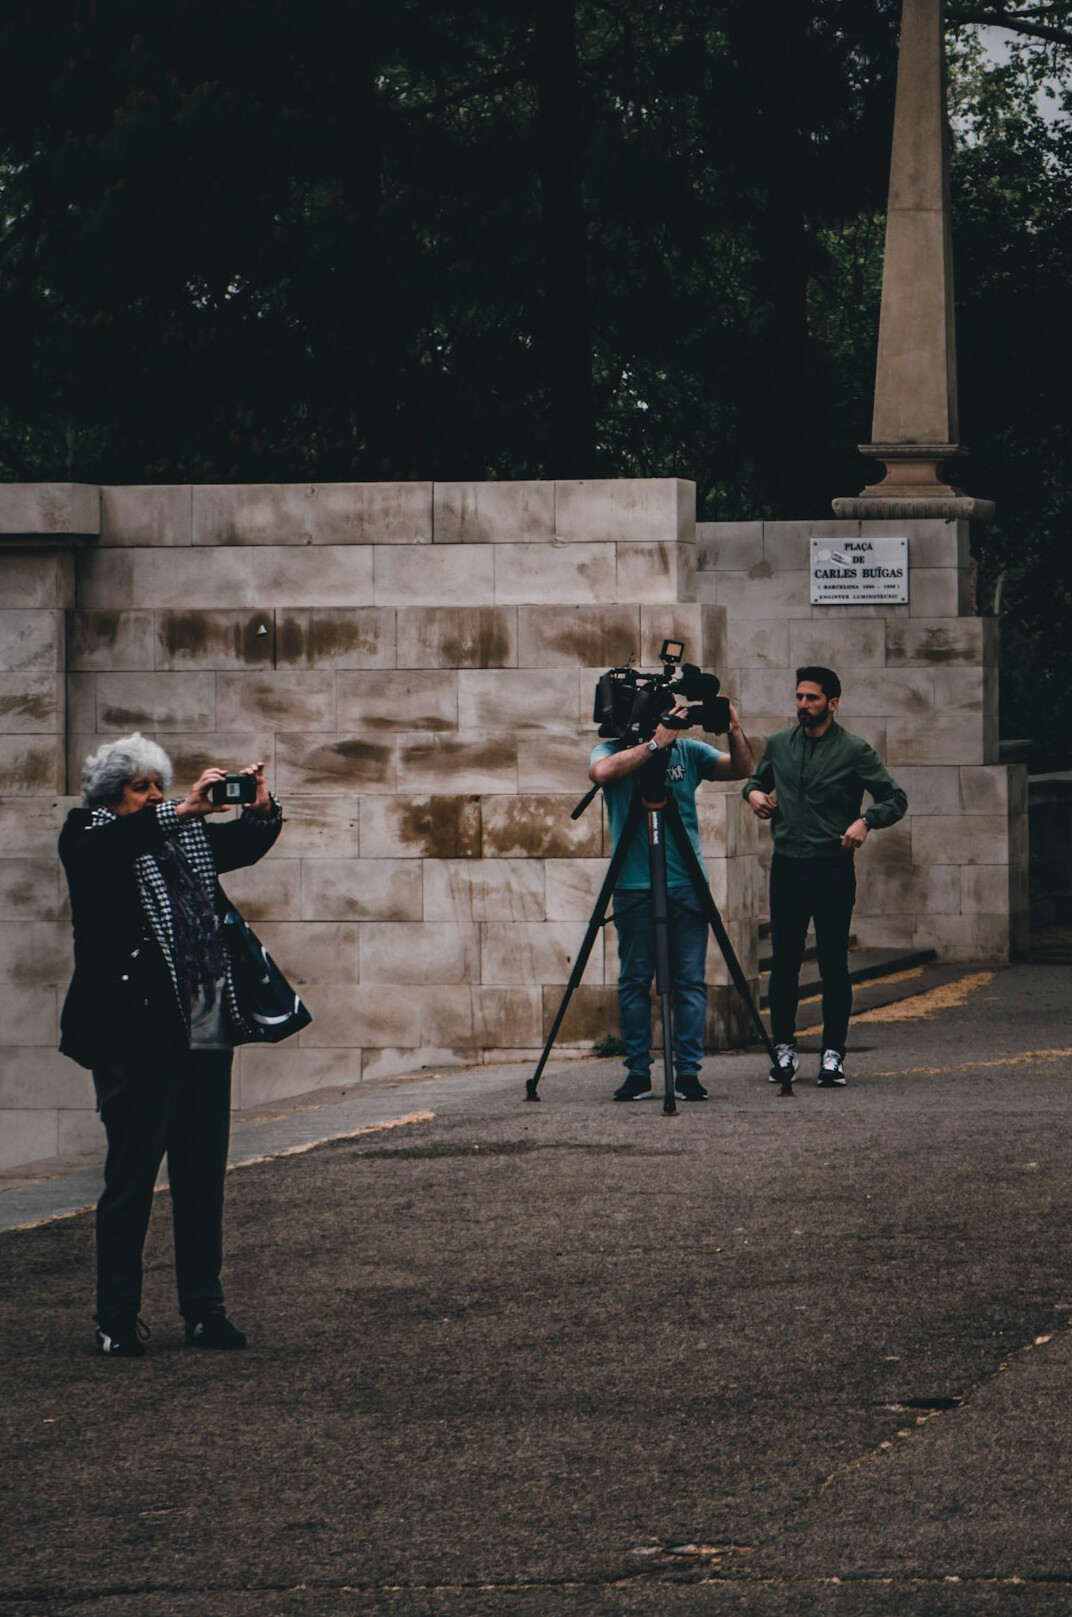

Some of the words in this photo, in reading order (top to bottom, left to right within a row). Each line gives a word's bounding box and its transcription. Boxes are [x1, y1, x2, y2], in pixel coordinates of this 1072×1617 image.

[845, 543, 873, 552] PLAÇA
[852, 556, 865, 564] DE
[815, 569, 857, 579] CARLES
[863, 567, 903, 578] BUÏGAS
